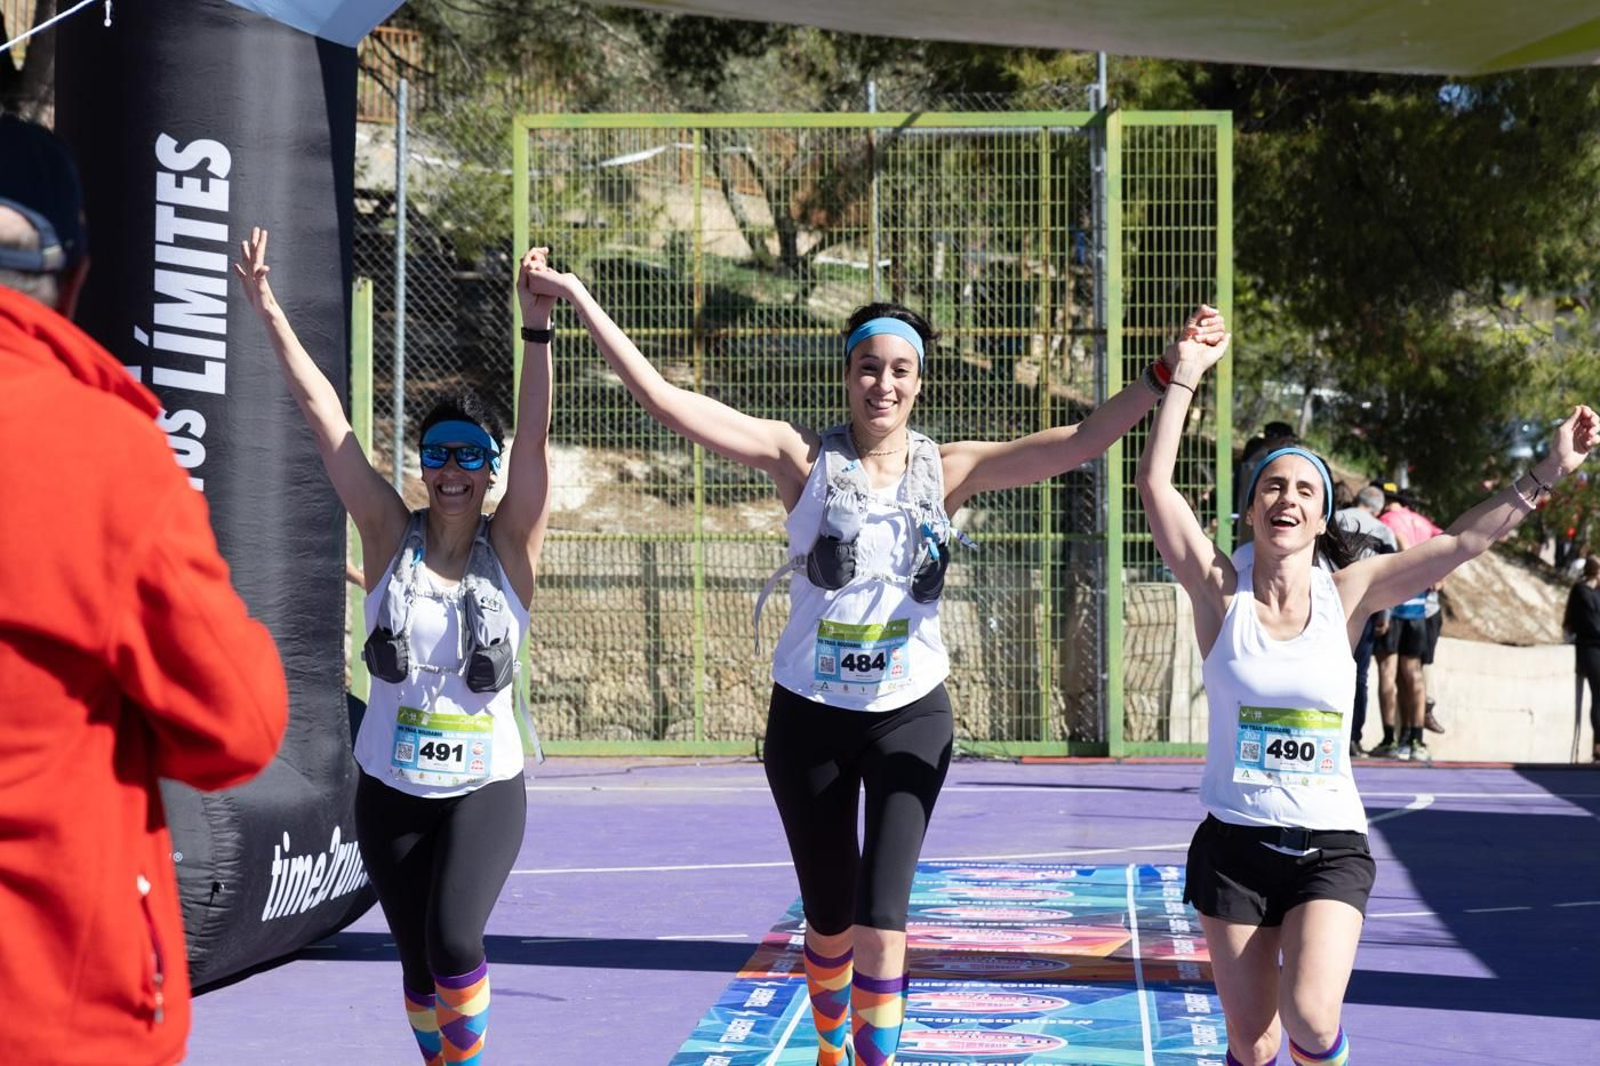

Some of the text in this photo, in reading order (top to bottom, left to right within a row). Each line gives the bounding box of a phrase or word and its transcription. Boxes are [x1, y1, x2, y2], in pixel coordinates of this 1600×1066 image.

[134, 132, 232, 395] LÍMITES
[840, 652, 886, 673] 484
[419, 741, 464, 763] 491
[1266, 738, 1315, 762] 490
